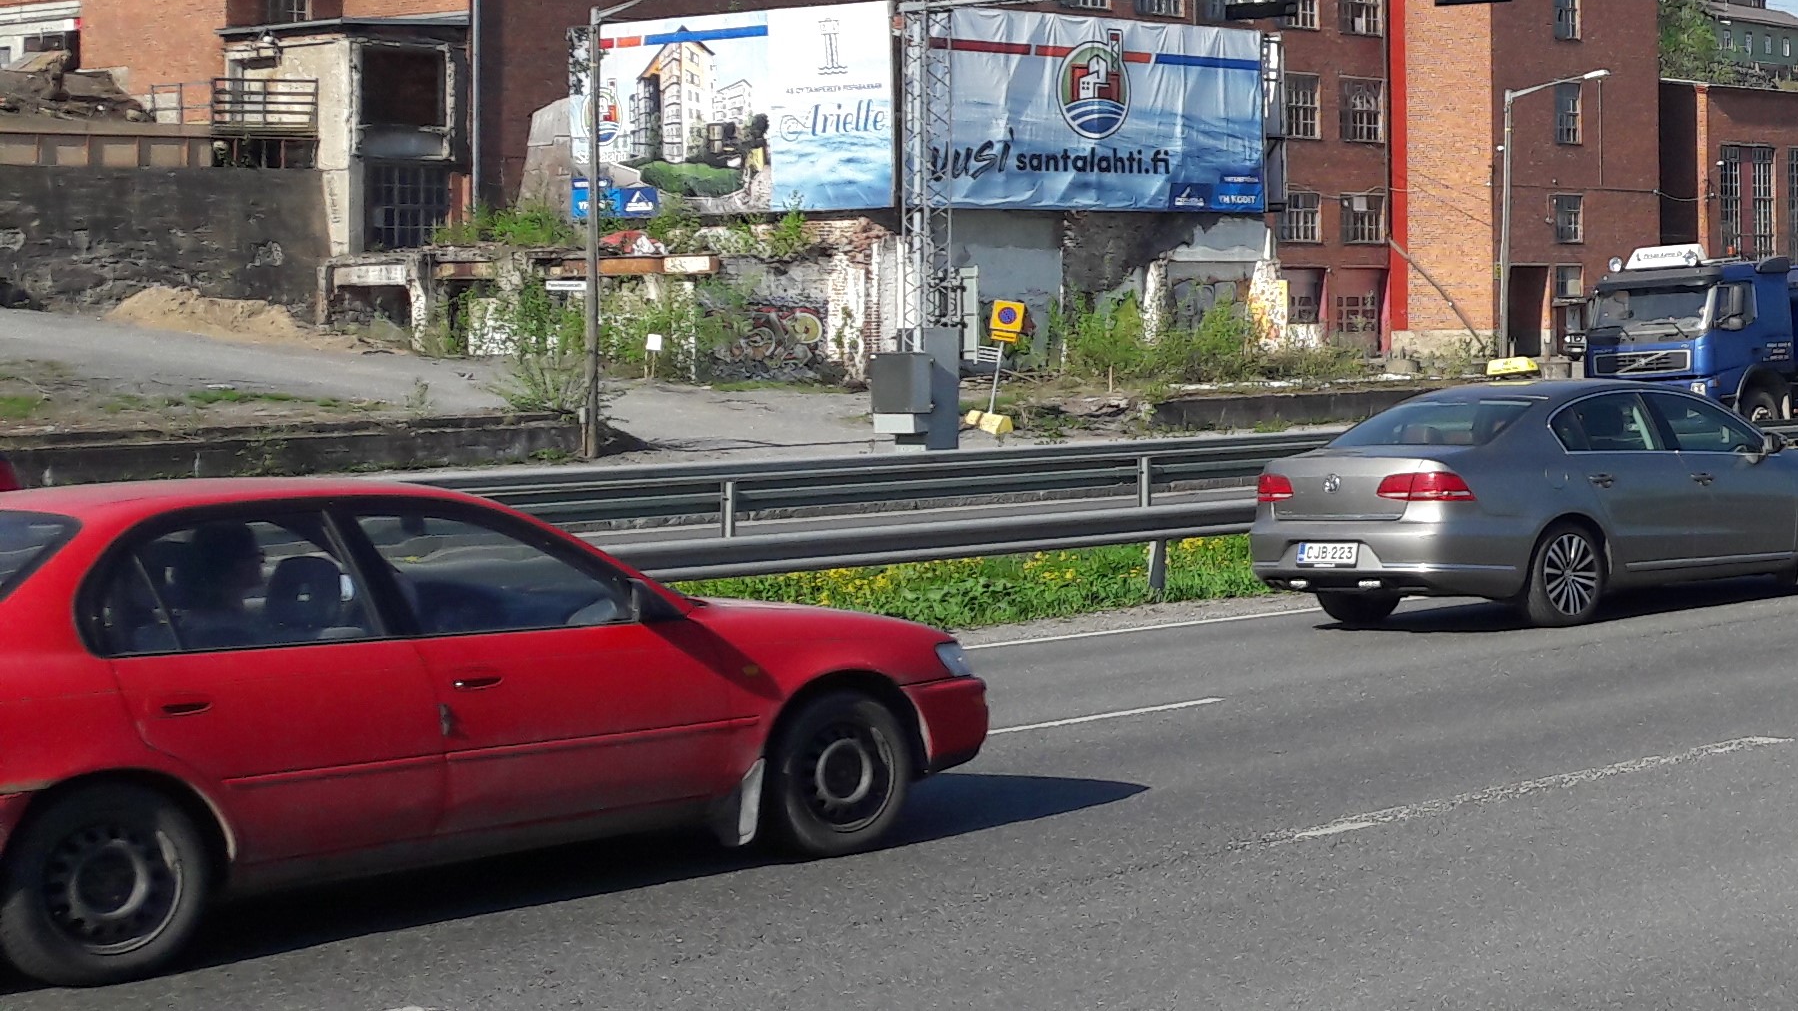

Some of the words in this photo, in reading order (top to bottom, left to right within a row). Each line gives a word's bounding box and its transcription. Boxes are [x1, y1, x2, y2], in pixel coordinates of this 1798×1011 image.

[780, 99, 885, 142] Arielle
[1016, 146, 1171, 175] santalahti.fi
[1306, 545, 1354, 560] CJB-223
